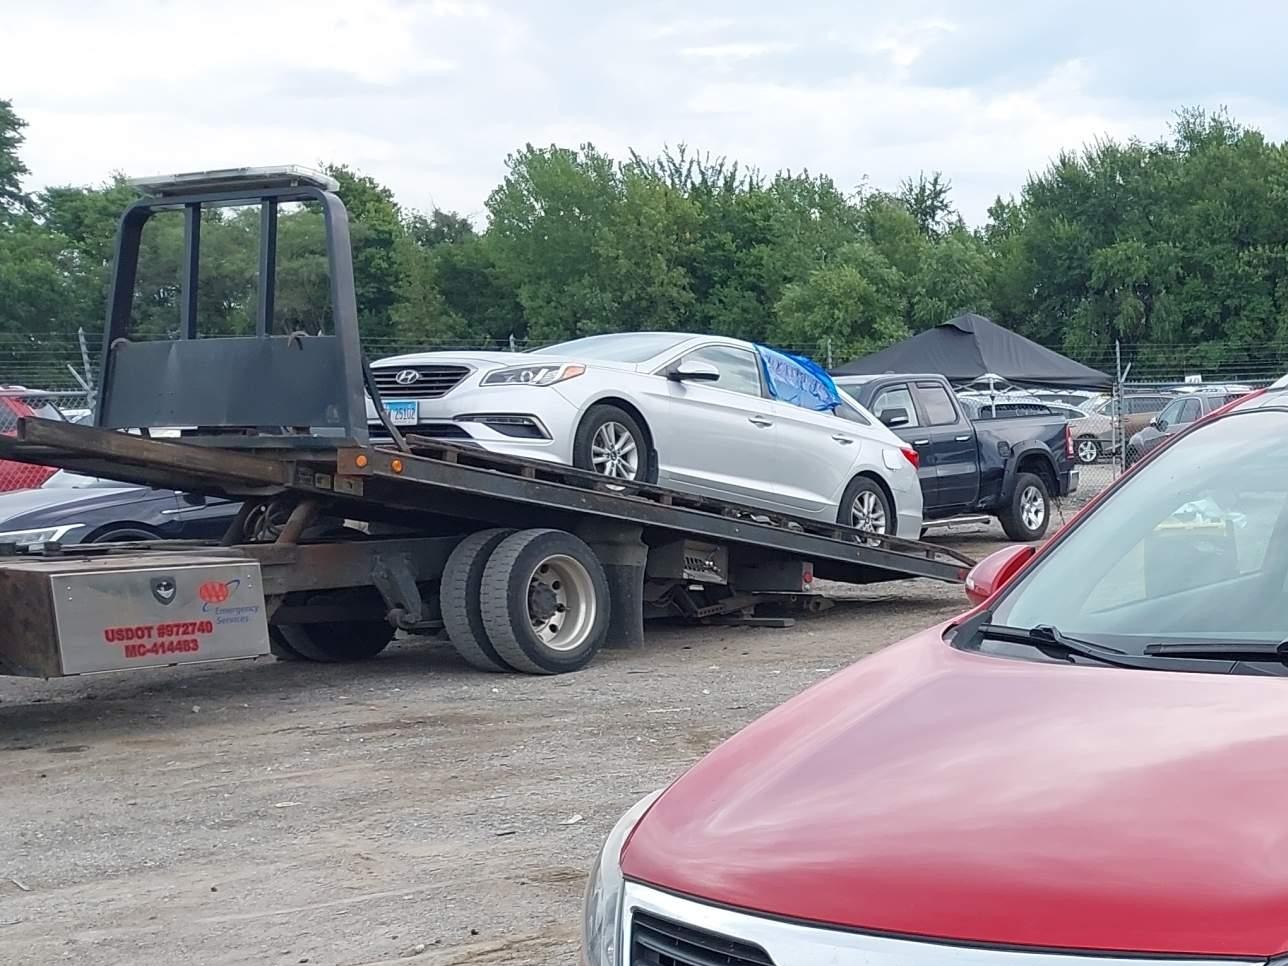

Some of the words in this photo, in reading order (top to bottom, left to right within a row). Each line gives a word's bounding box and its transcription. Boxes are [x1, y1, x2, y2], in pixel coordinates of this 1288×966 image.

[216, 606, 258, 616] Emergency
[216, 615, 248, 624] Services
[104, 626, 154, 642] USDOT
[157, 621, 213, 638] #972740
